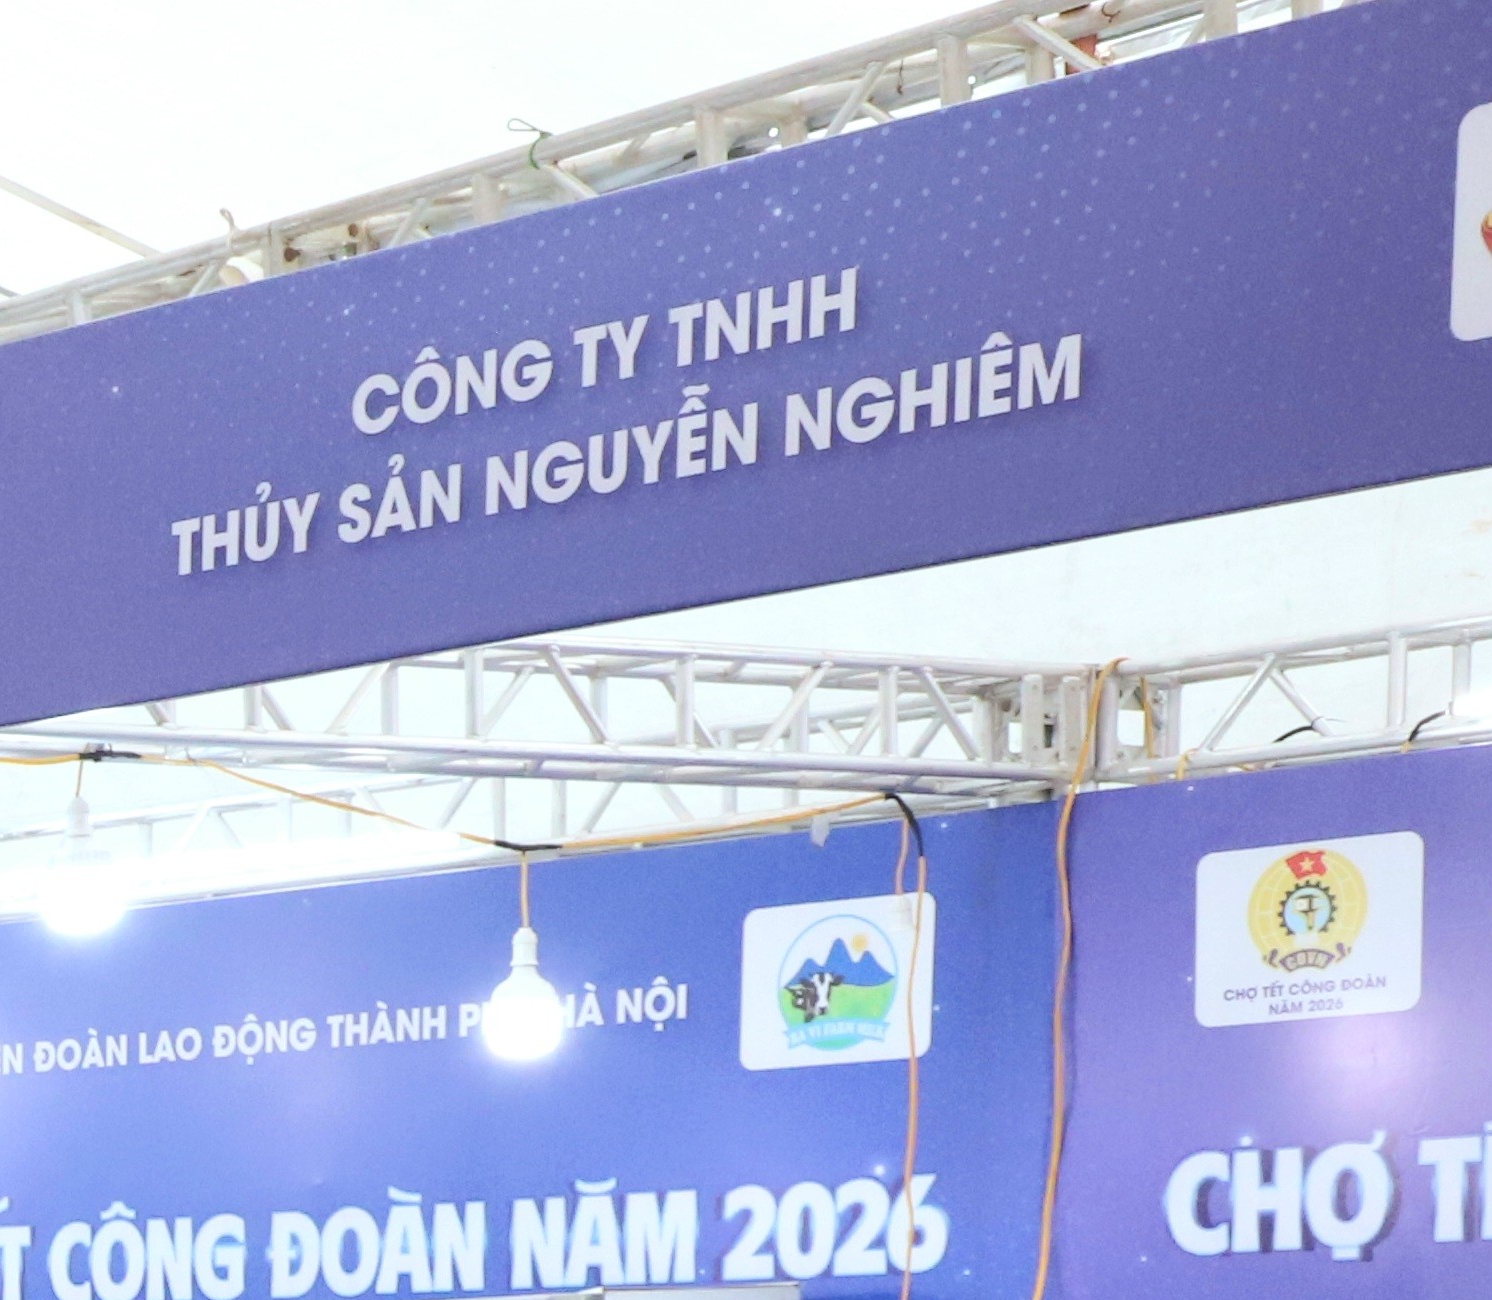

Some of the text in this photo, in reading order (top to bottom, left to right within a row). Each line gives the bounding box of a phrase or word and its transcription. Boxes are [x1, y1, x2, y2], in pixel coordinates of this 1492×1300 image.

[352, 267, 858, 435] CÔNG TY TNHH
[171, 330, 1084, 577] THỦY SẢN NGUYỄN NGHIÊM
[33, 1026, 128, 1072] ĐOÀN
[137, 1026, 203, 1064] LAO
[211, 1015, 317, 1066] ĐỘNG
[326, 1002, 447, 1050] THÀNH
[616, 975, 689, 1035] NỘI
[1223, 987, 1258, 1002] CHỢ
[1262, 980, 1284, 999] TẾT
[1288, 978, 1335, 995] CÔNG
[1268, 998, 1344, 1015] NĂM 2026
[266, 1186, 488, 1300] ĐOÀN
[510, 1178, 698, 1290] NĂM
[723, 1171, 950, 1281] 2026
[1163, 1128, 1395, 1262] CHỢ
